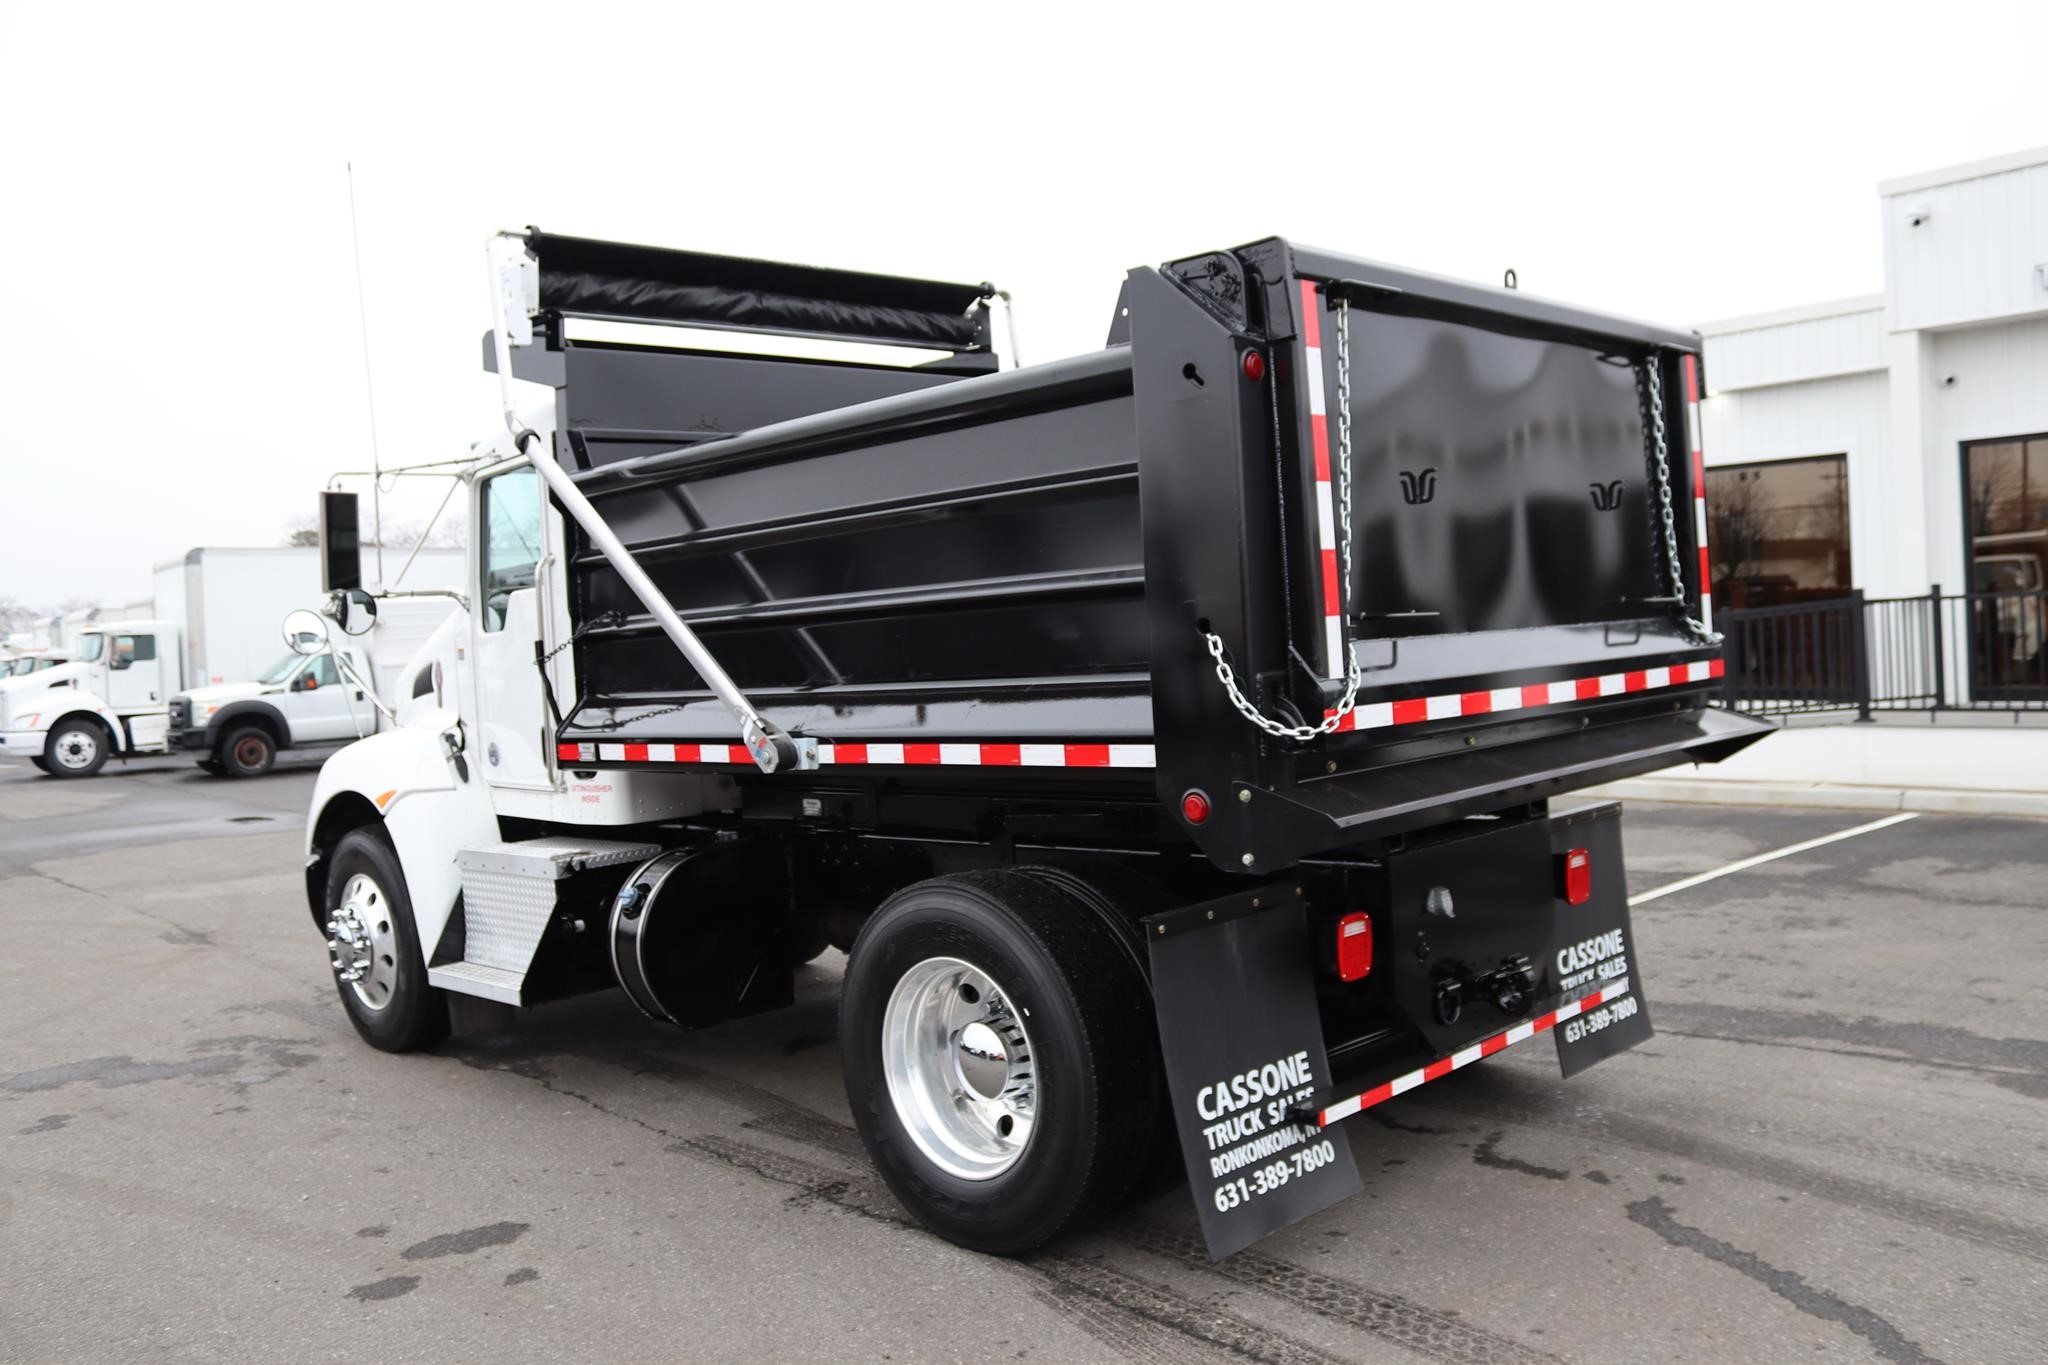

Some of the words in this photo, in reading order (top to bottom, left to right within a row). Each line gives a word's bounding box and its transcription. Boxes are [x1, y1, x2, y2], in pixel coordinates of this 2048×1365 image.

[1557, 928, 1625, 975] CASSONE
[1597, 955, 1628, 981] SALES
[1565, 996, 1638, 1043] 631-389-7800
[1196, 1051, 1313, 1121] CASSONE
[1203, 1108, 1266, 1150] TRUCK
[1209, 1123, 1306, 1178] RONKONKOMA,
[1214, 1139, 1336, 1213] 631-389-7800
